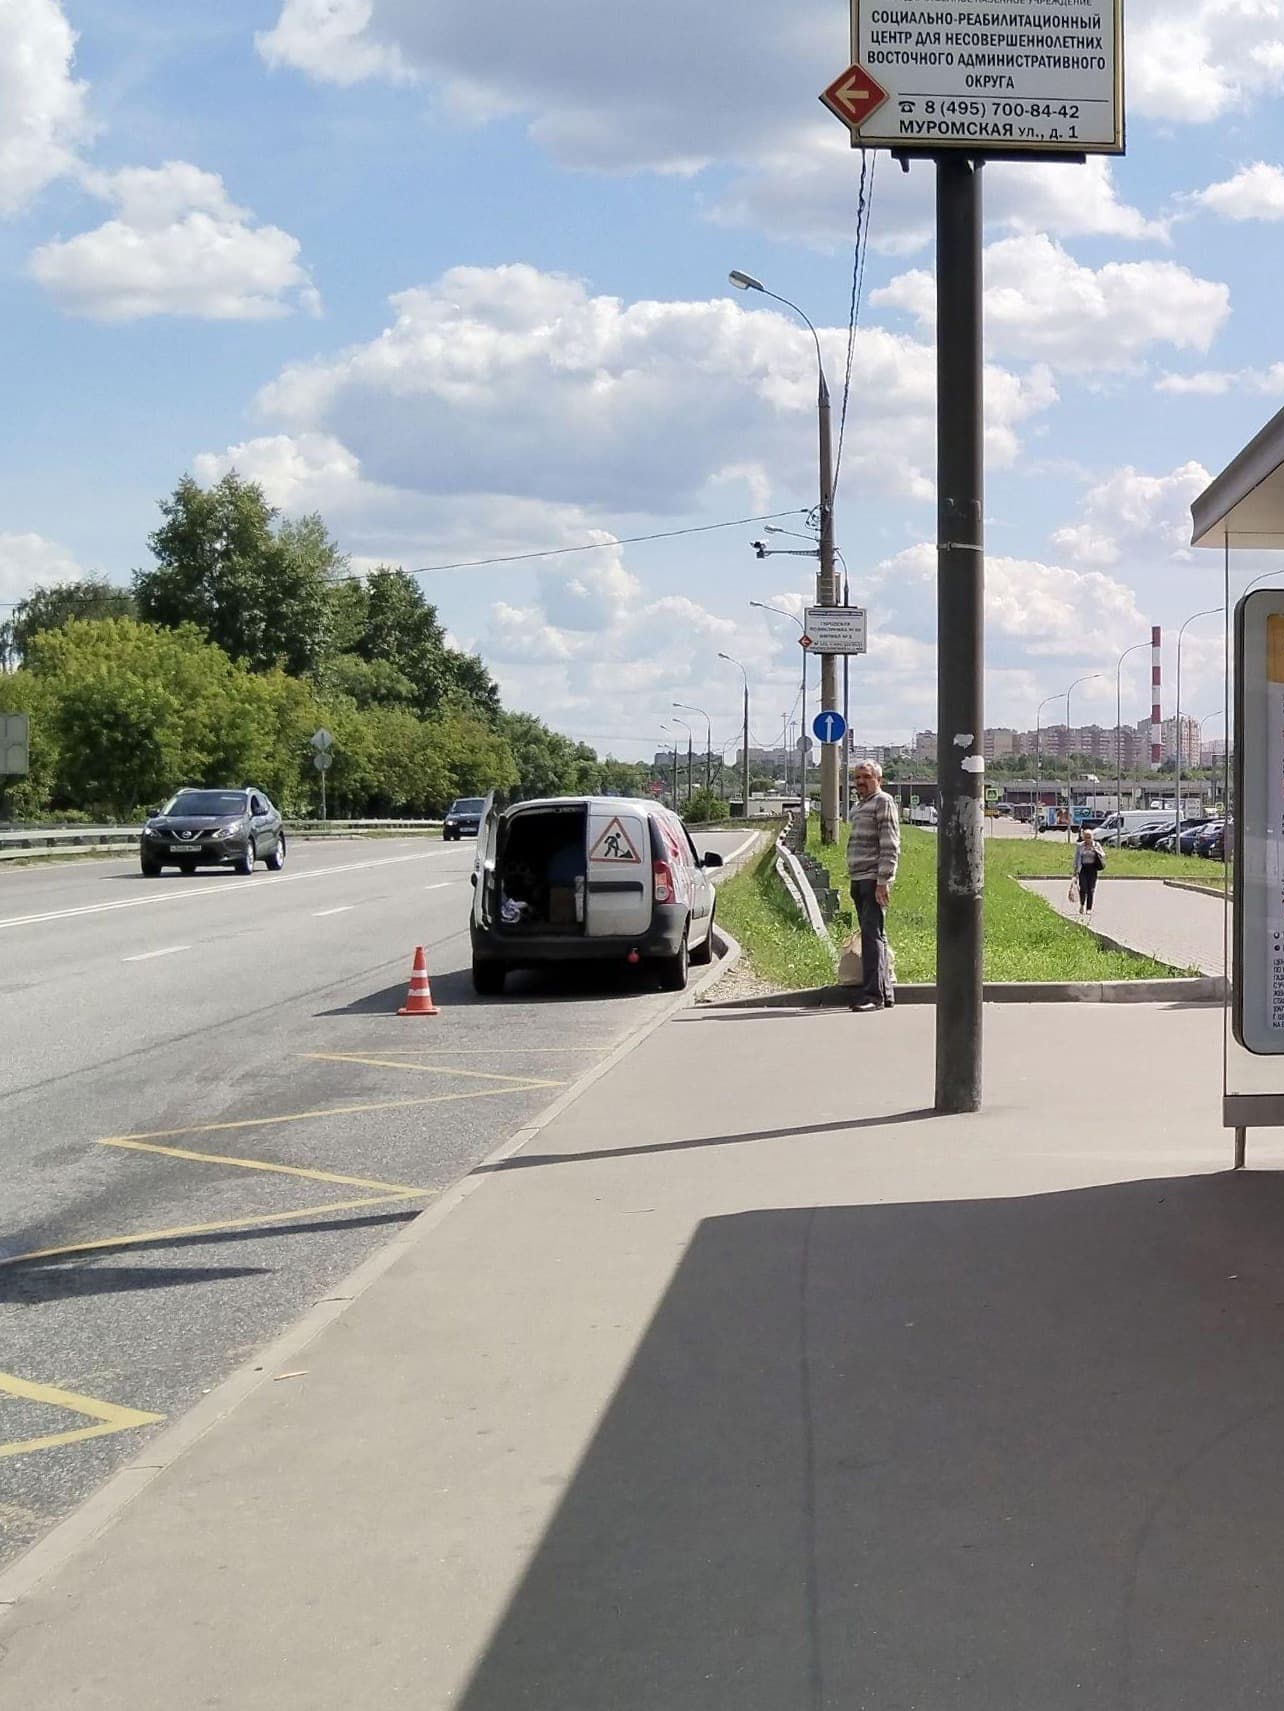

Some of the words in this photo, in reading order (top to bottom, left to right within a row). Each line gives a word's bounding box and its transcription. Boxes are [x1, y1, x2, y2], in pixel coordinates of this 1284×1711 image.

[871, 10, 1101, 30] СОЦИАЛЬНО-РЕАБИЛИТАЦИОННЫЙ
[871, 30, 912, 46] ЦЕНТР
[915, 32, 941, 47] ДЛЯ
[945, 33, 1103, 50] НЕСОВЕРШЕННОЛЕТНИХ
[867, 50, 954, 66] ВОСТОЧНОГО
[957, 53, 1106, 70] АДМИНИСТРАТИВНОГО
[965, 75, 1015, 89] ОКРУГА
[925, 101, 936, 114] 8
[940, 102, 987, 118] (495)
[992, 103, 1080, 118] 700-84-42
[899, 119, 1013, 137] МУРОМСКАЯ
[1018, 127, 1045, 140] ул.,
[1049, 129, 1064, 140] д.
[1069, 125, 1079, 138] 1
